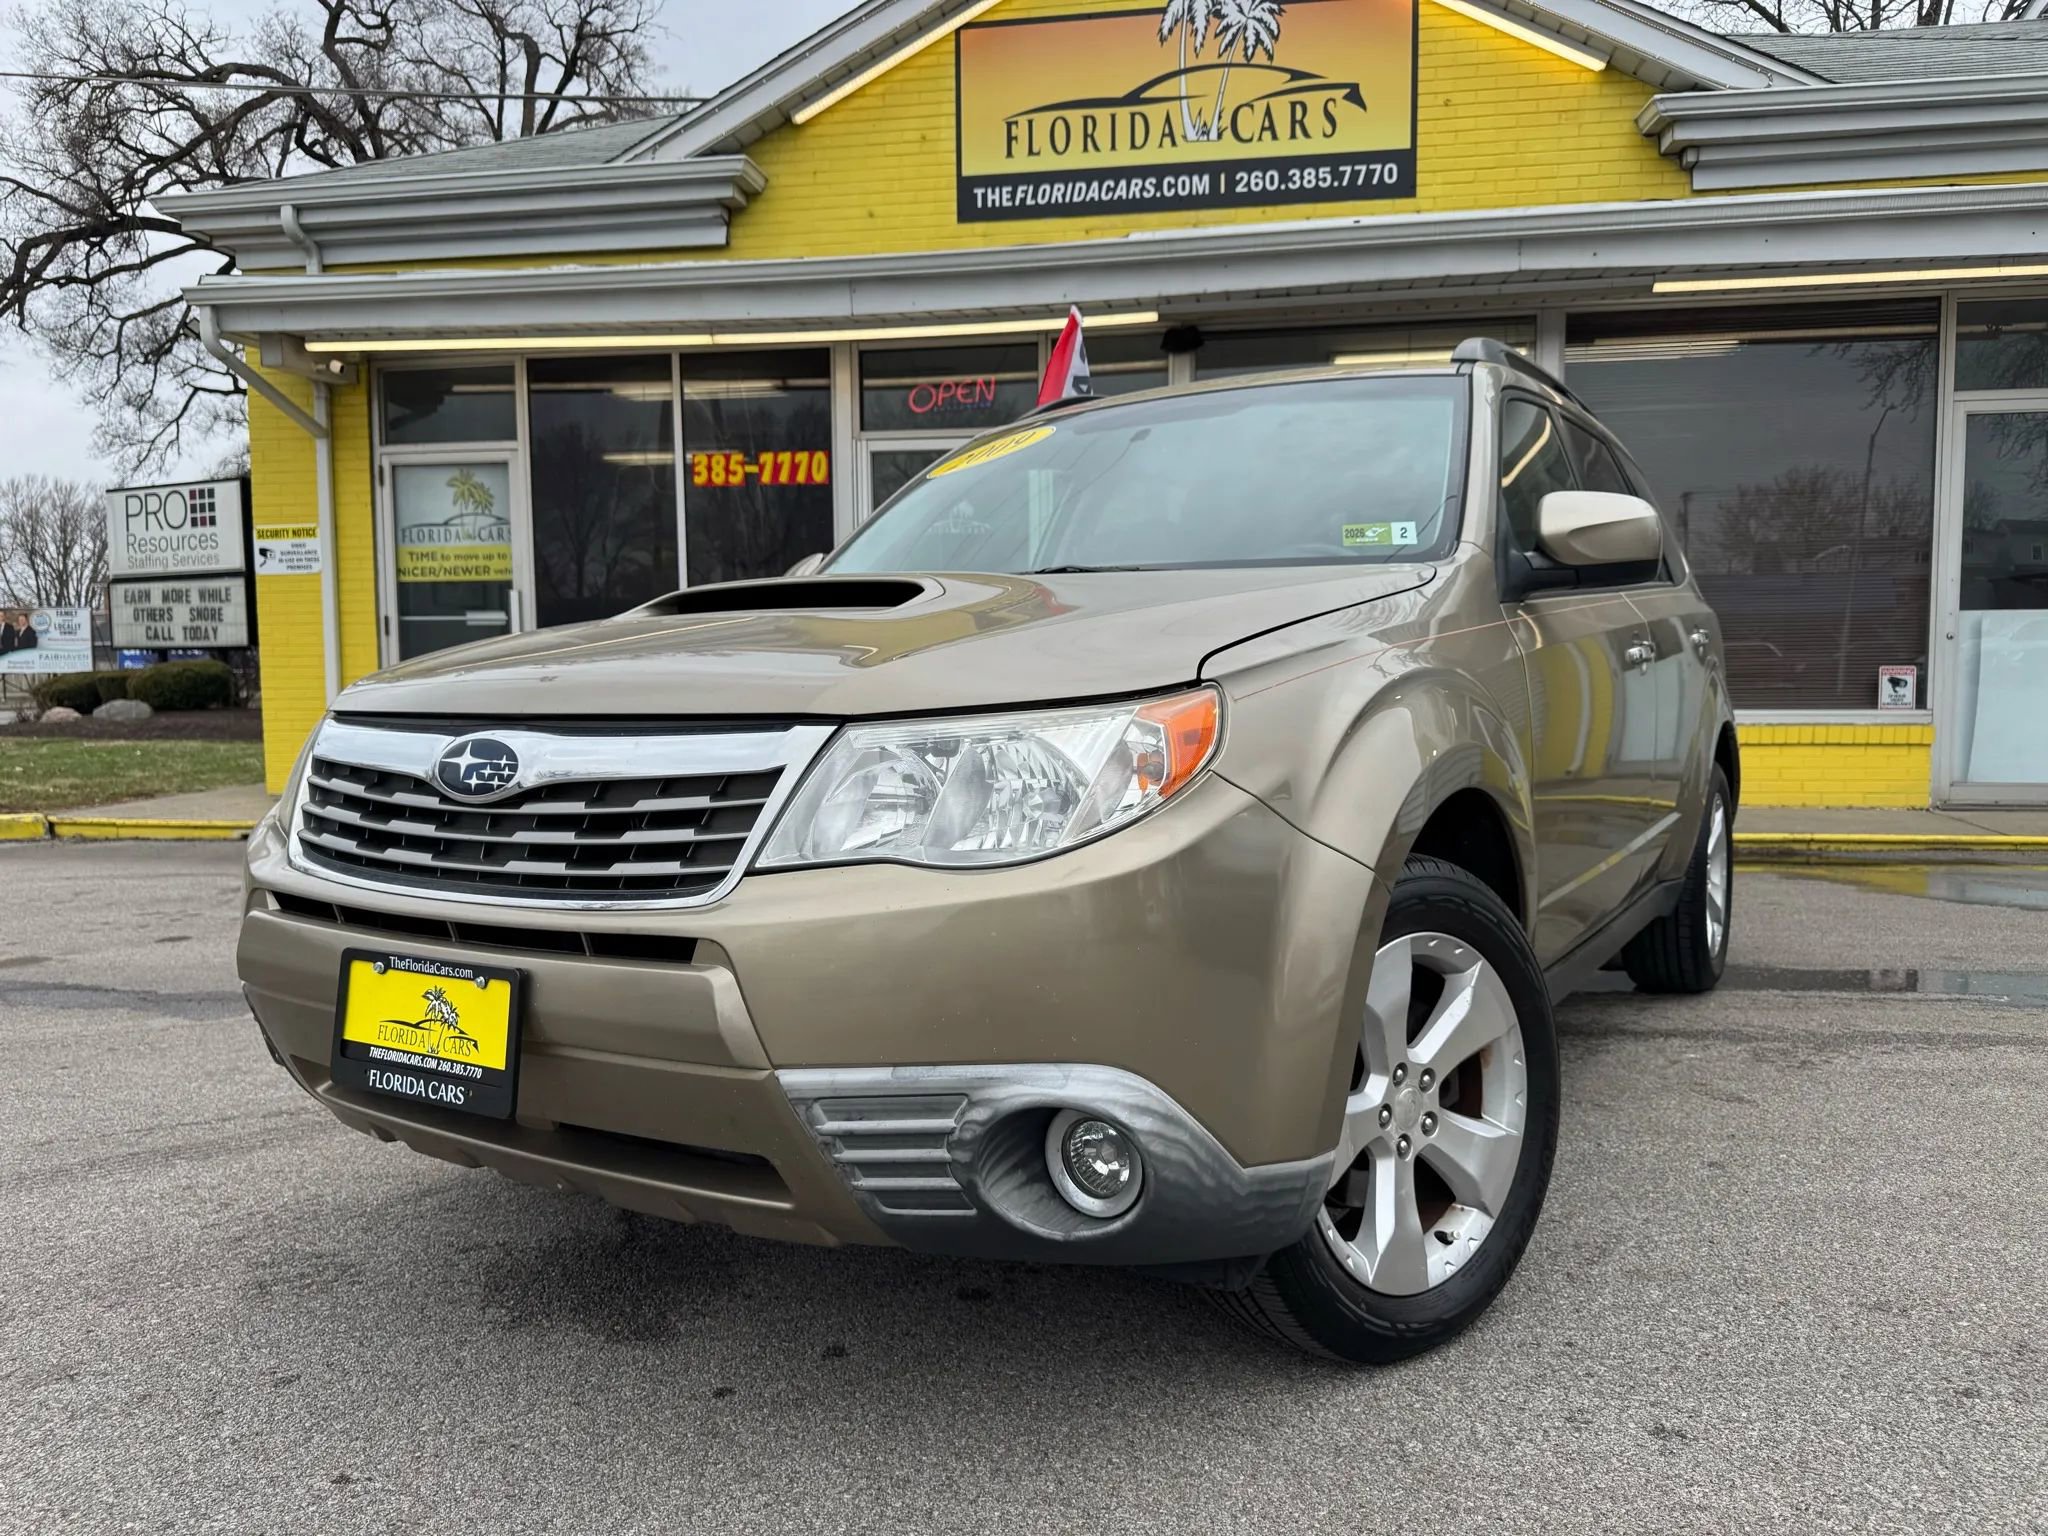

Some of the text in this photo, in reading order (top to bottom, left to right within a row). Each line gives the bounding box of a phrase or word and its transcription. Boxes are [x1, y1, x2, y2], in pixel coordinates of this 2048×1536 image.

[1004, 97, 1338, 159] FLORIDA CARS
[973, 162, 1398, 208] THEFLORIDACARS.COM 260.385.7770
[908, 377, 995, 413] OPEN
[693, 451, 828, 485] 385-7770
[125, 490, 188, 532] PRO
[126, 532, 219, 554] Resources
[256, 527, 316, 539] SECURITY NOTICE
[402, 527, 461, 543] FLORIDA
[1400, 527, 1408, 538] 2
[128, 553, 220, 570] Staffing Services
[408, 551, 507, 562] TIME to move up to
[398, 565, 490, 578] NICER/NEWER
[124, 587, 231, 604] EARN MORE WHILE
[133, 607, 224, 623] OTHERS SNORE
[145, 626, 219, 641] CALL TODAY
[389, 956, 473, 979] TheFloridaCars.com
[377, 1024, 472, 1057] FLORIDA CARS
[369, 1046, 482, 1079] THEFLORIDACARS.COM 260.385.7770
[369, 1069, 465, 1104] FLORIDA CARS
